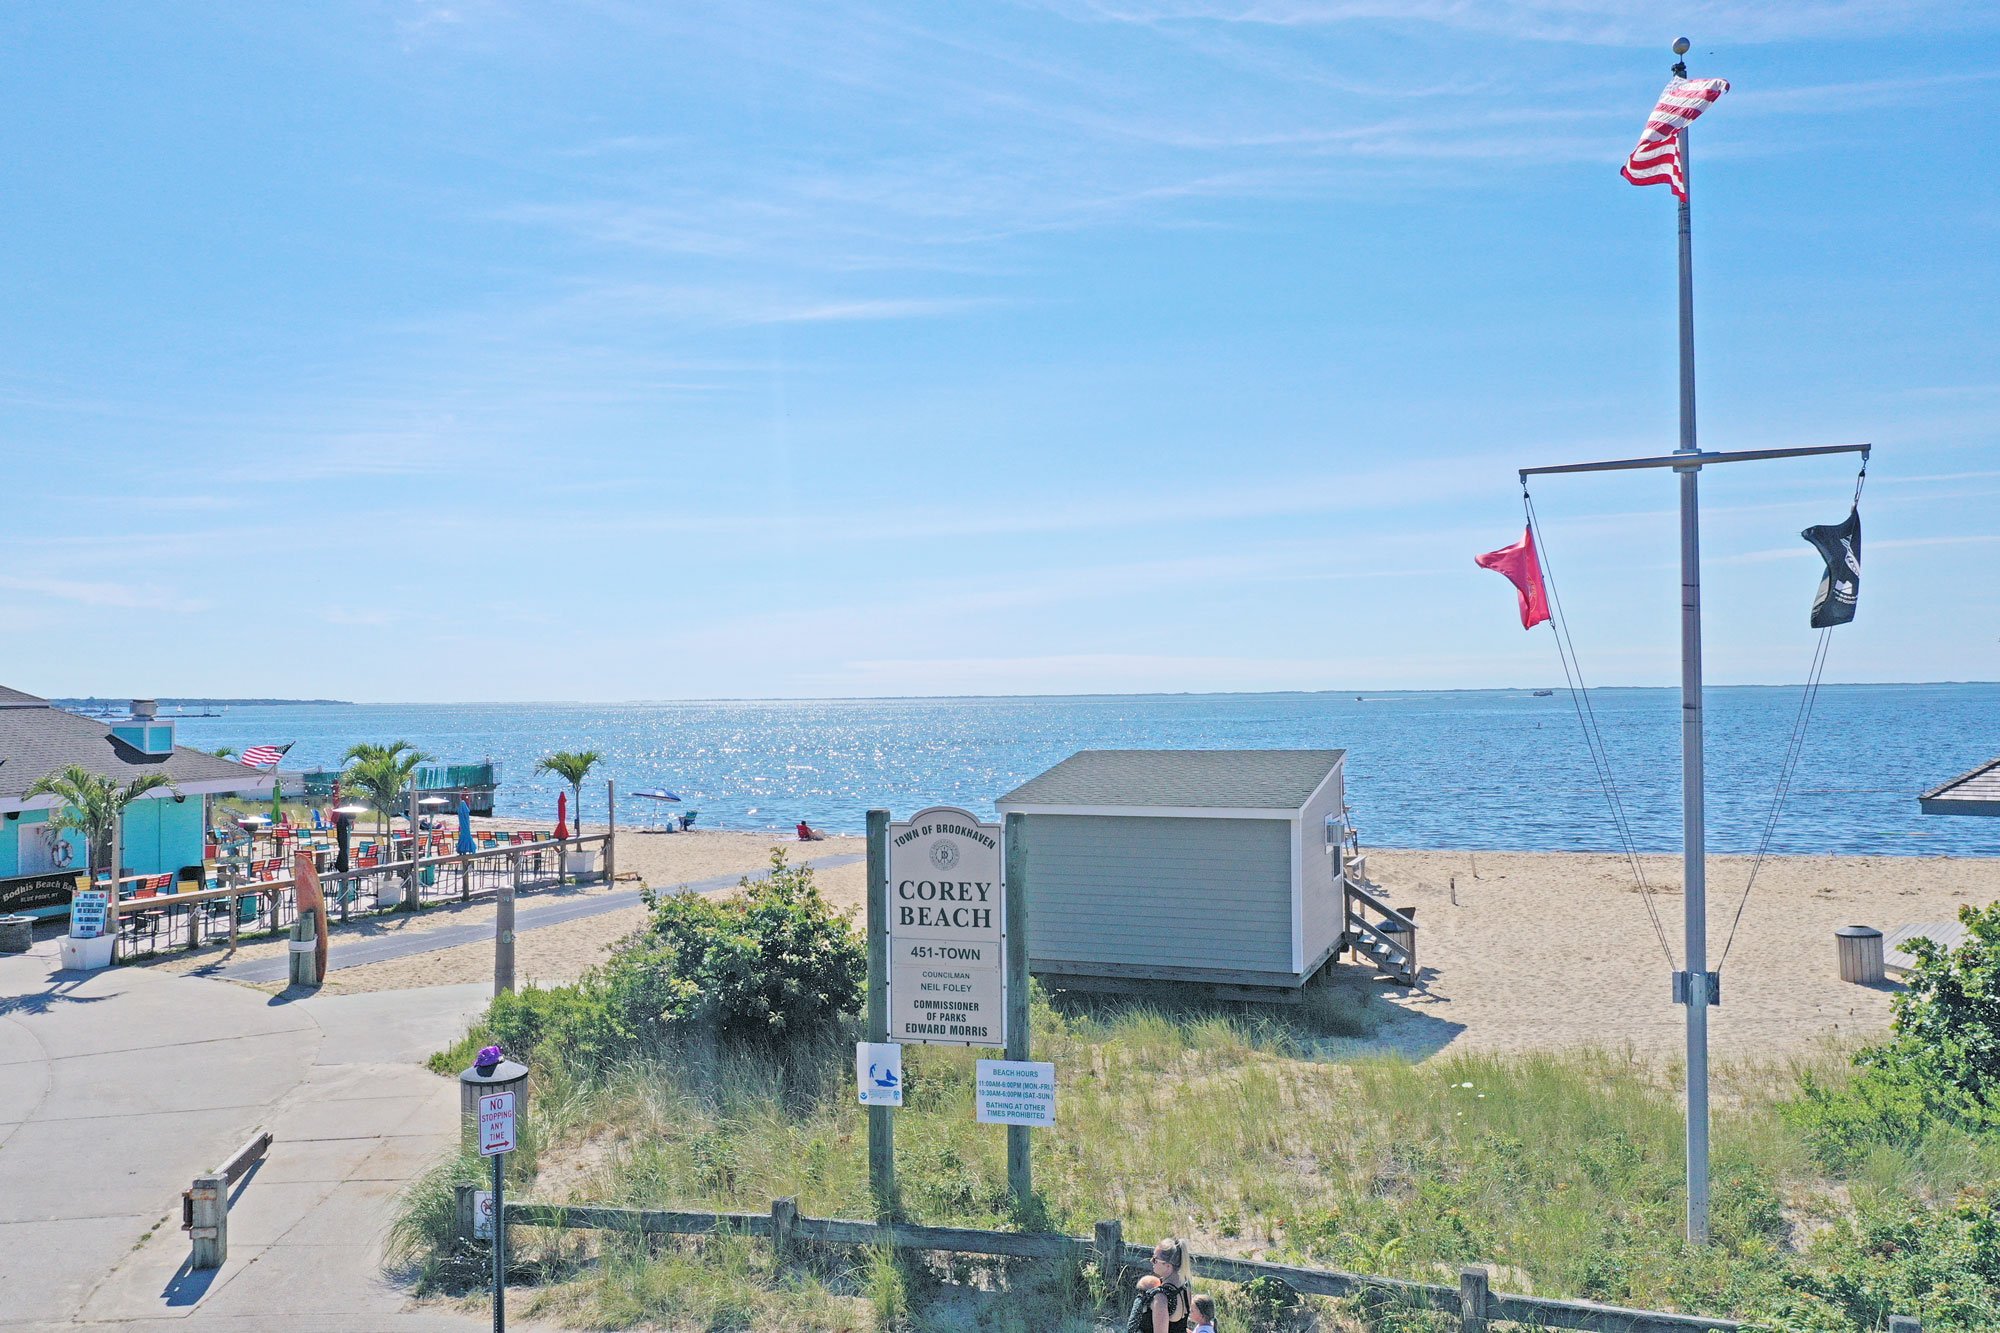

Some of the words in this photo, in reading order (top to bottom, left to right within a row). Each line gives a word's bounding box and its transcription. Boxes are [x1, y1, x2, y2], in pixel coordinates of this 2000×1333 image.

[894, 828, 920, 847] TOWN
[922, 825, 932, 836] OF
[936, 824, 996, 850] BROOKHAVEN
[36, 880, 60, 888] Beach
[899, 880, 992, 902] COREY
[899, 906, 992, 928] BEACH
[911, 946, 980, 960] 451-TOWN
[922, 971, 970, 979] COUNCILMAN
[920, 983, 940, 992] NEIL
[943, 984, 972, 992] FOLEY
[914, 1000, 979, 1012] COMMISSIONER
[926, 1012, 936, 1021] OF
[940, 1012, 966, 1022] PARKS
[906, 1023, 946, 1034] EDWARD
[950, 1025, 988, 1036] MORRIS
[490, 1099, 503, 1110] NO
[986, 1102, 1013, 1110] BATHING
[482, 1110, 512, 1122] STOPPING
[1006, 1111, 1044, 1119] PROHIBITED
[490, 1122, 504, 1130] ANY
[490, 1132, 504, 1140] TIME
